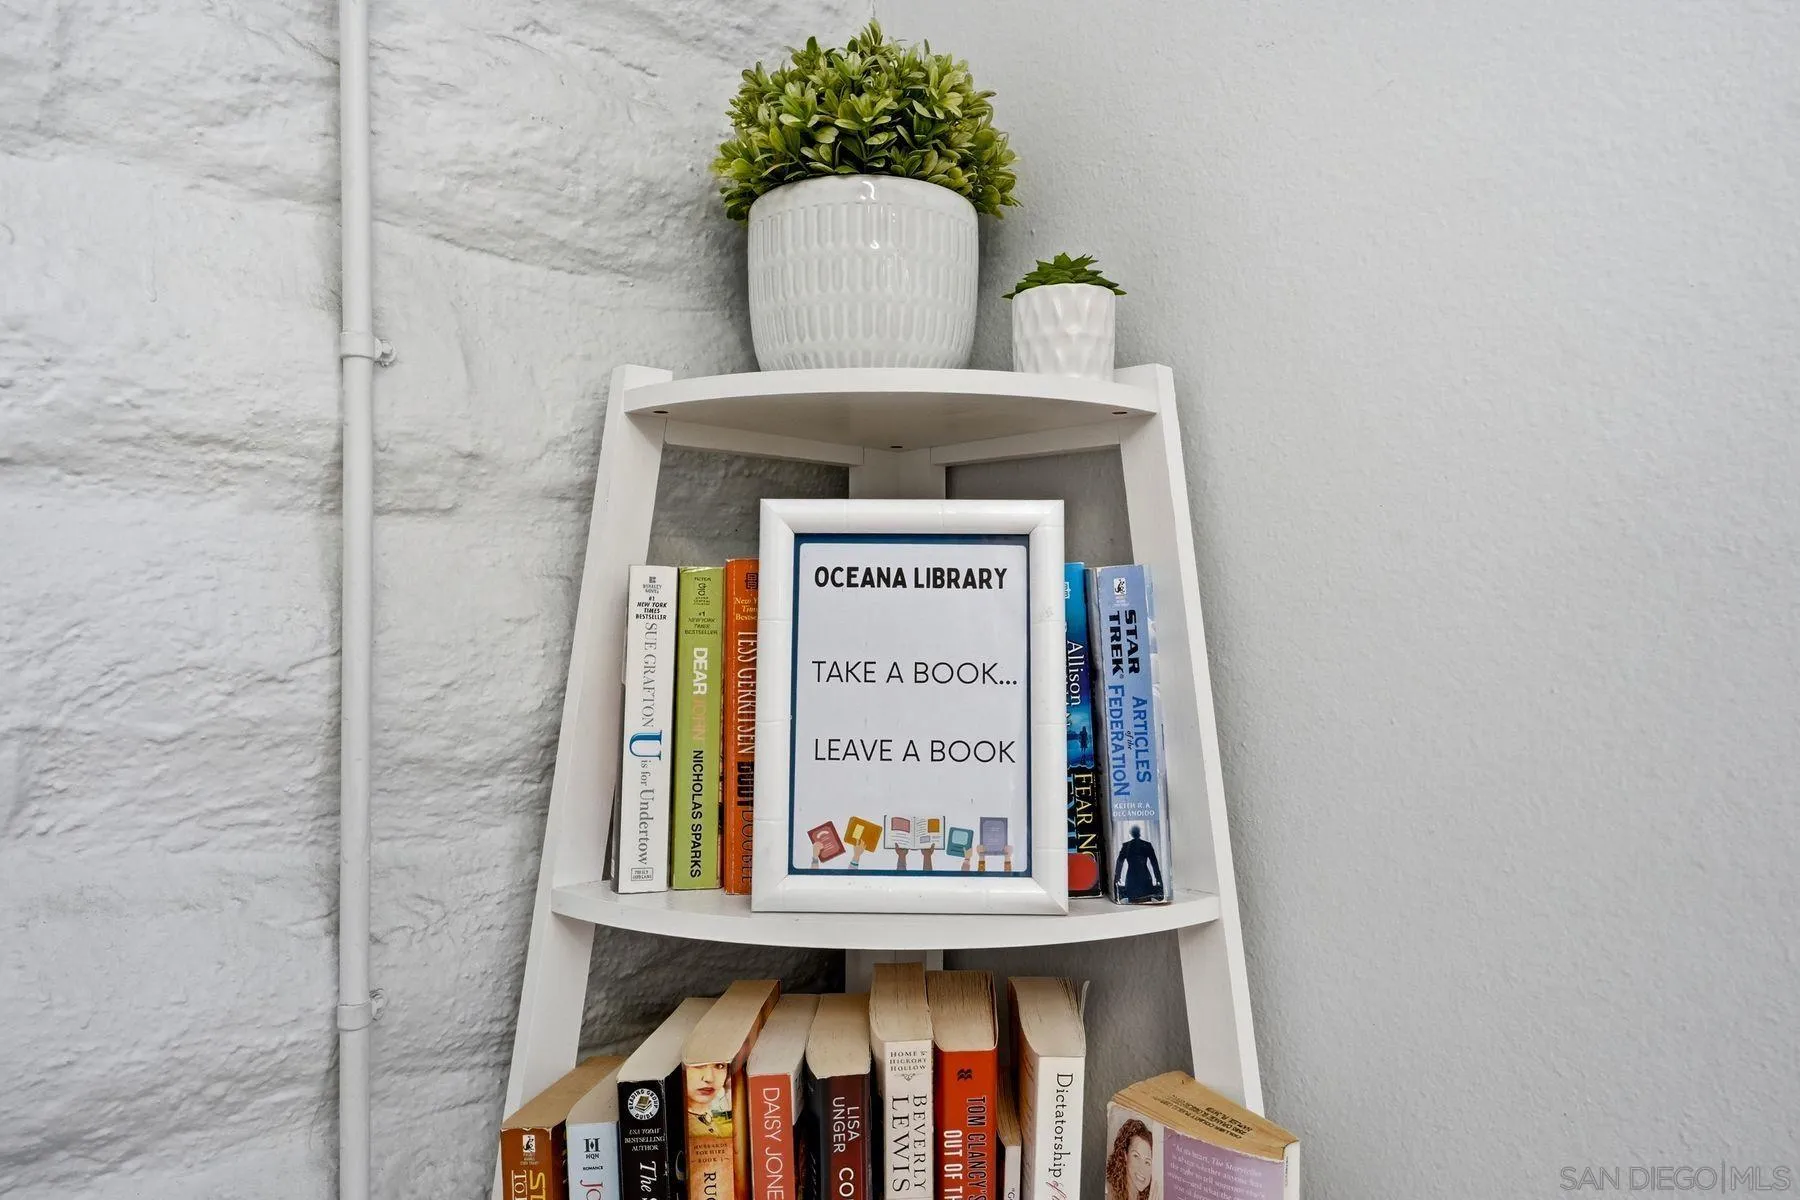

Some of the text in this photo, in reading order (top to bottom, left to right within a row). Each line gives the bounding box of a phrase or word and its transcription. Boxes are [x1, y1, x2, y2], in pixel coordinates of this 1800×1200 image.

[814, 566, 1008, 590] OCEANA LIBRARY
[1125, 609, 1140, 674] STAR
[641, 622, 657, 727] SUE GRAFTON
[692, 647, 708, 695] DEAR
[812, 660, 1018, 685] TAKE A BOOK...
[1067, 640, 1085, 706] Allison
[737, 668, 757, 754] GERRITSEN
[629, 730, 662, 760] U
[815, 738, 1016, 763] LEAVE A BOOK
[1108, 685, 1130, 796] FEDERATION
[1125, 730, 1135, 750] of the
[1132, 696, 1152, 783] ARTICLES
[640, 771, 651, 787] for
[641, 760, 651, 769] is
[690, 750, 704, 878] NICHOLAS SPARKS
[1074, 772, 1093, 826] FEAR
[638, 789, 655, 865] Undertow
[890, 1064, 927, 1072] HOLLOW
[634, 1112, 654, 1120] GUIDE
[763, 1087, 782, 1142] DAISY
[832, 1096, 846, 1153] UNGER
[847, 1106, 860, 1142] LISA
[967, 1096, 987, 1127] TOM
[1048, 1073, 1074, 1178] Dictatorship
[624, 1136, 666, 1144] BESTSELLING
[631, 1144, 660, 1152] AUTHOR
[891, 1095, 910, 1192] LEWIS
[913, 1094, 927, 1192] BEVERLY
[943, 1129, 963, 1157] OUT
[640, 1160, 658, 1193] The
[703, 1171, 717, 1200] RU
[943, 1165, 963, 1180] OF
